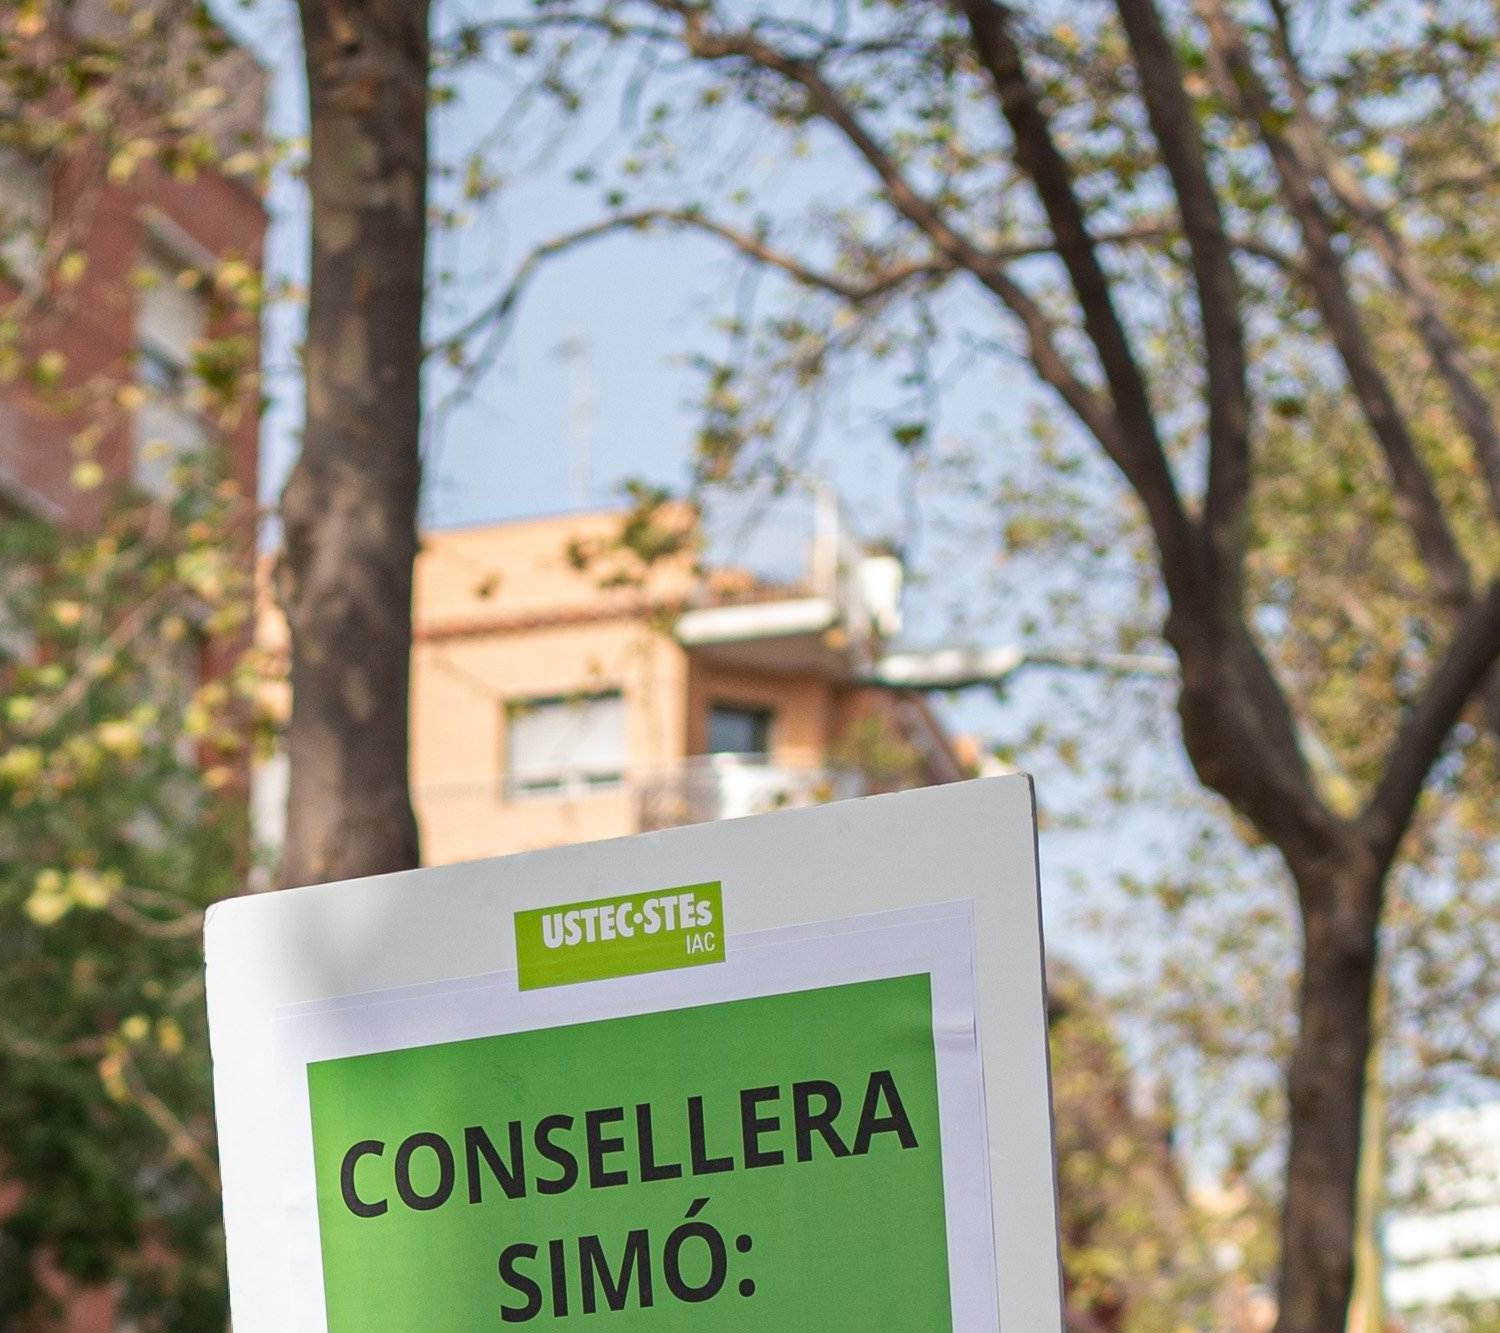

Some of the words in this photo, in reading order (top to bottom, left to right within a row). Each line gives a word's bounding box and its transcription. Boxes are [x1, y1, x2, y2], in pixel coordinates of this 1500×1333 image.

[685, 931, 716, 955] IAC
[339, 1069, 920, 1219] CONSELLERA
[498, 1197, 757, 1323] SIMÓ:
